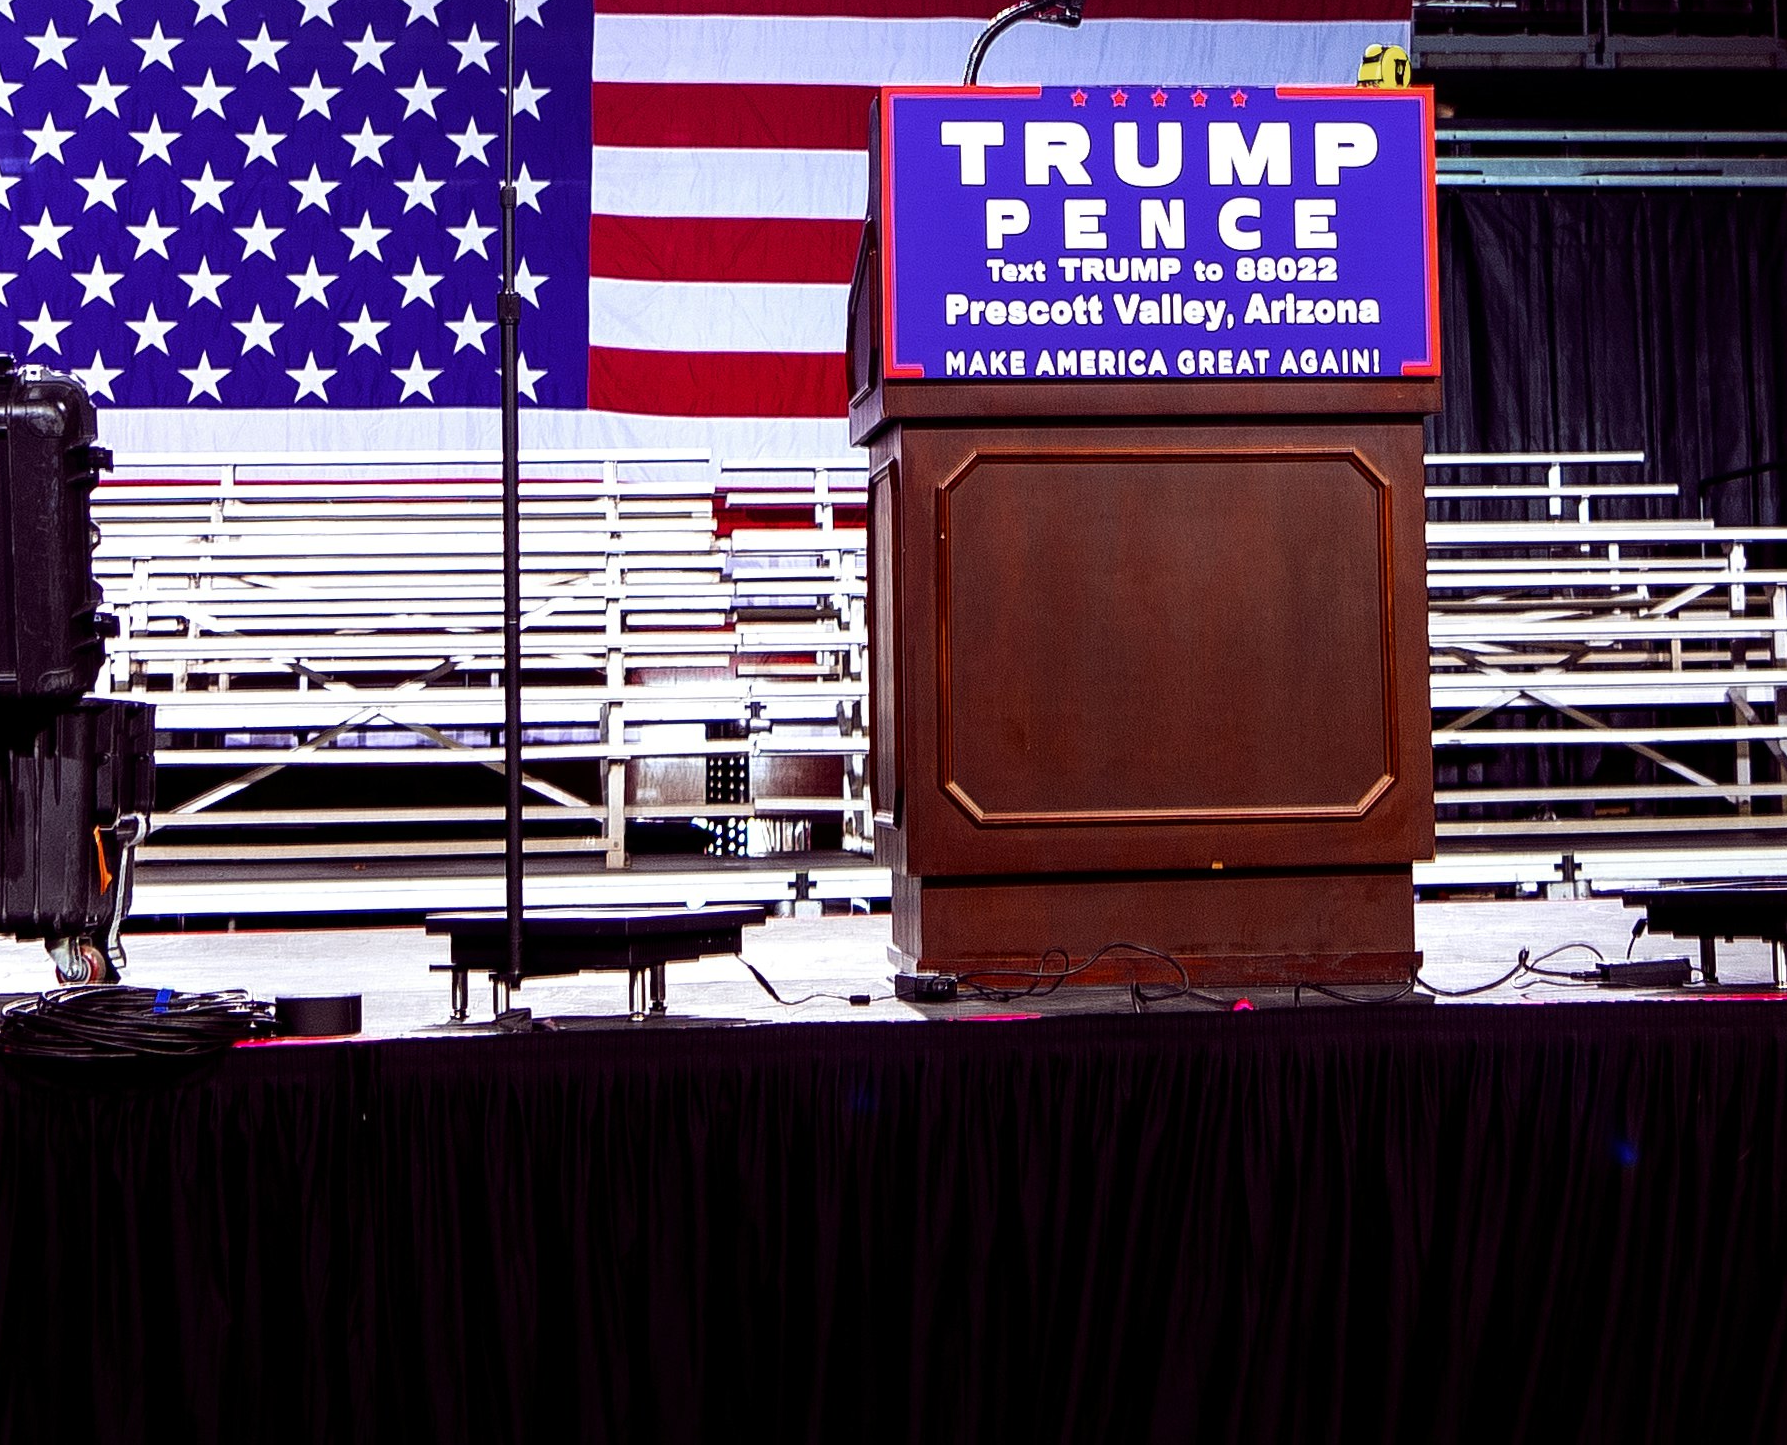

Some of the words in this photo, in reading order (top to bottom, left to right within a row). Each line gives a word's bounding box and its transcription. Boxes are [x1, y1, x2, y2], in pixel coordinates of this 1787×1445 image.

[940, 120, 1379, 188] TRUMP
[985, 197, 1339, 252] PENCE
[986, 258, 1046, 283] Text
[1058, 258, 1182, 283] TRUMP
[1194, 260, 1224, 283] to
[1235, 258, 1339, 283] 88022
[945, 293, 1104, 326] Prescott
[1116, 293, 1235, 331] Valley,
[1244, 293, 1380, 326] Arizona
[945, 350, 1026, 376] MAKE
[1035, 349, 1168, 376] AMERICA
[1177, 349, 1270, 376] GREAT
[1279, 349, 1381, 376] AGAIN!
